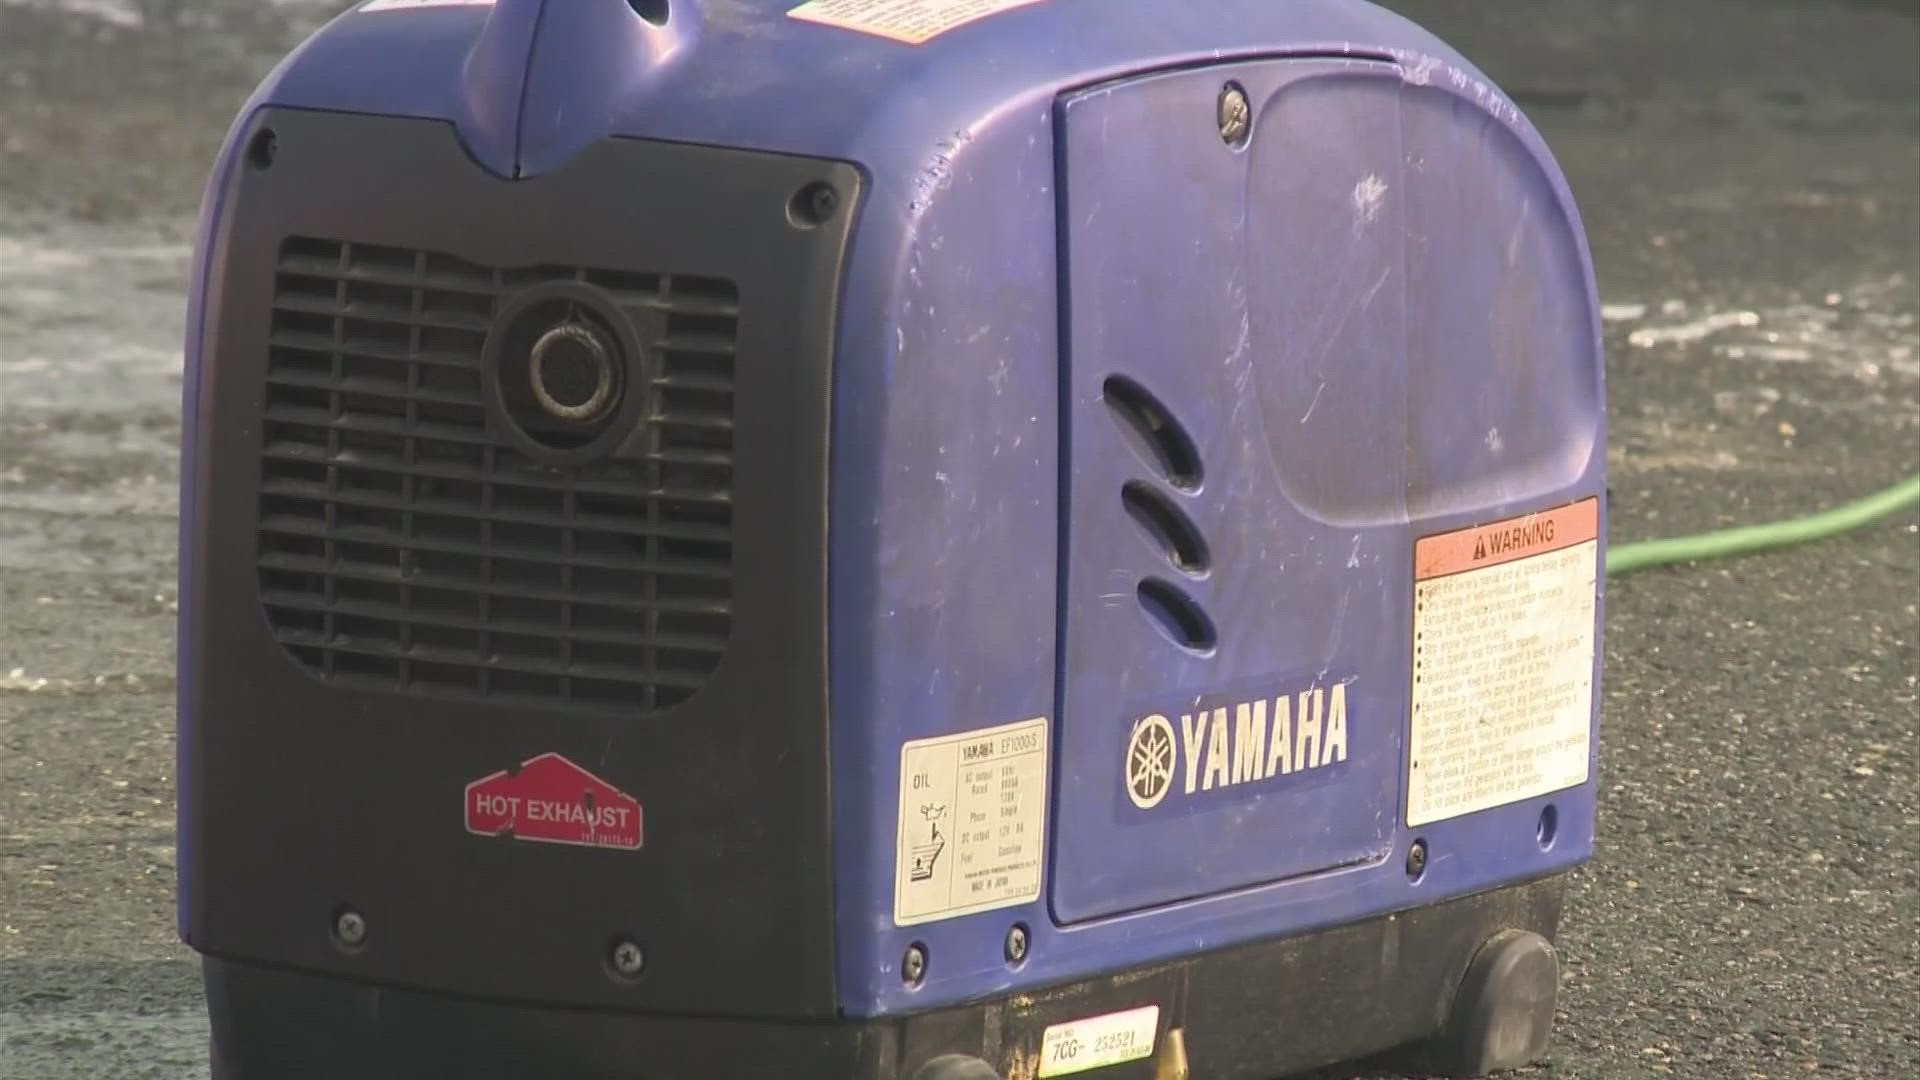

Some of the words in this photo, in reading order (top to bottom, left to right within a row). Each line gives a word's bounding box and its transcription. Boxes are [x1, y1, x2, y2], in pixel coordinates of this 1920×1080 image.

[1489, 519, 1555, 555] WARNING
[1180, 682, 1348, 795] YAMAHA
[912, 773, 931, 790] OIL
[476, 793, 521, 818] HOT
[527, 799, 631, 828] EXHAUST
